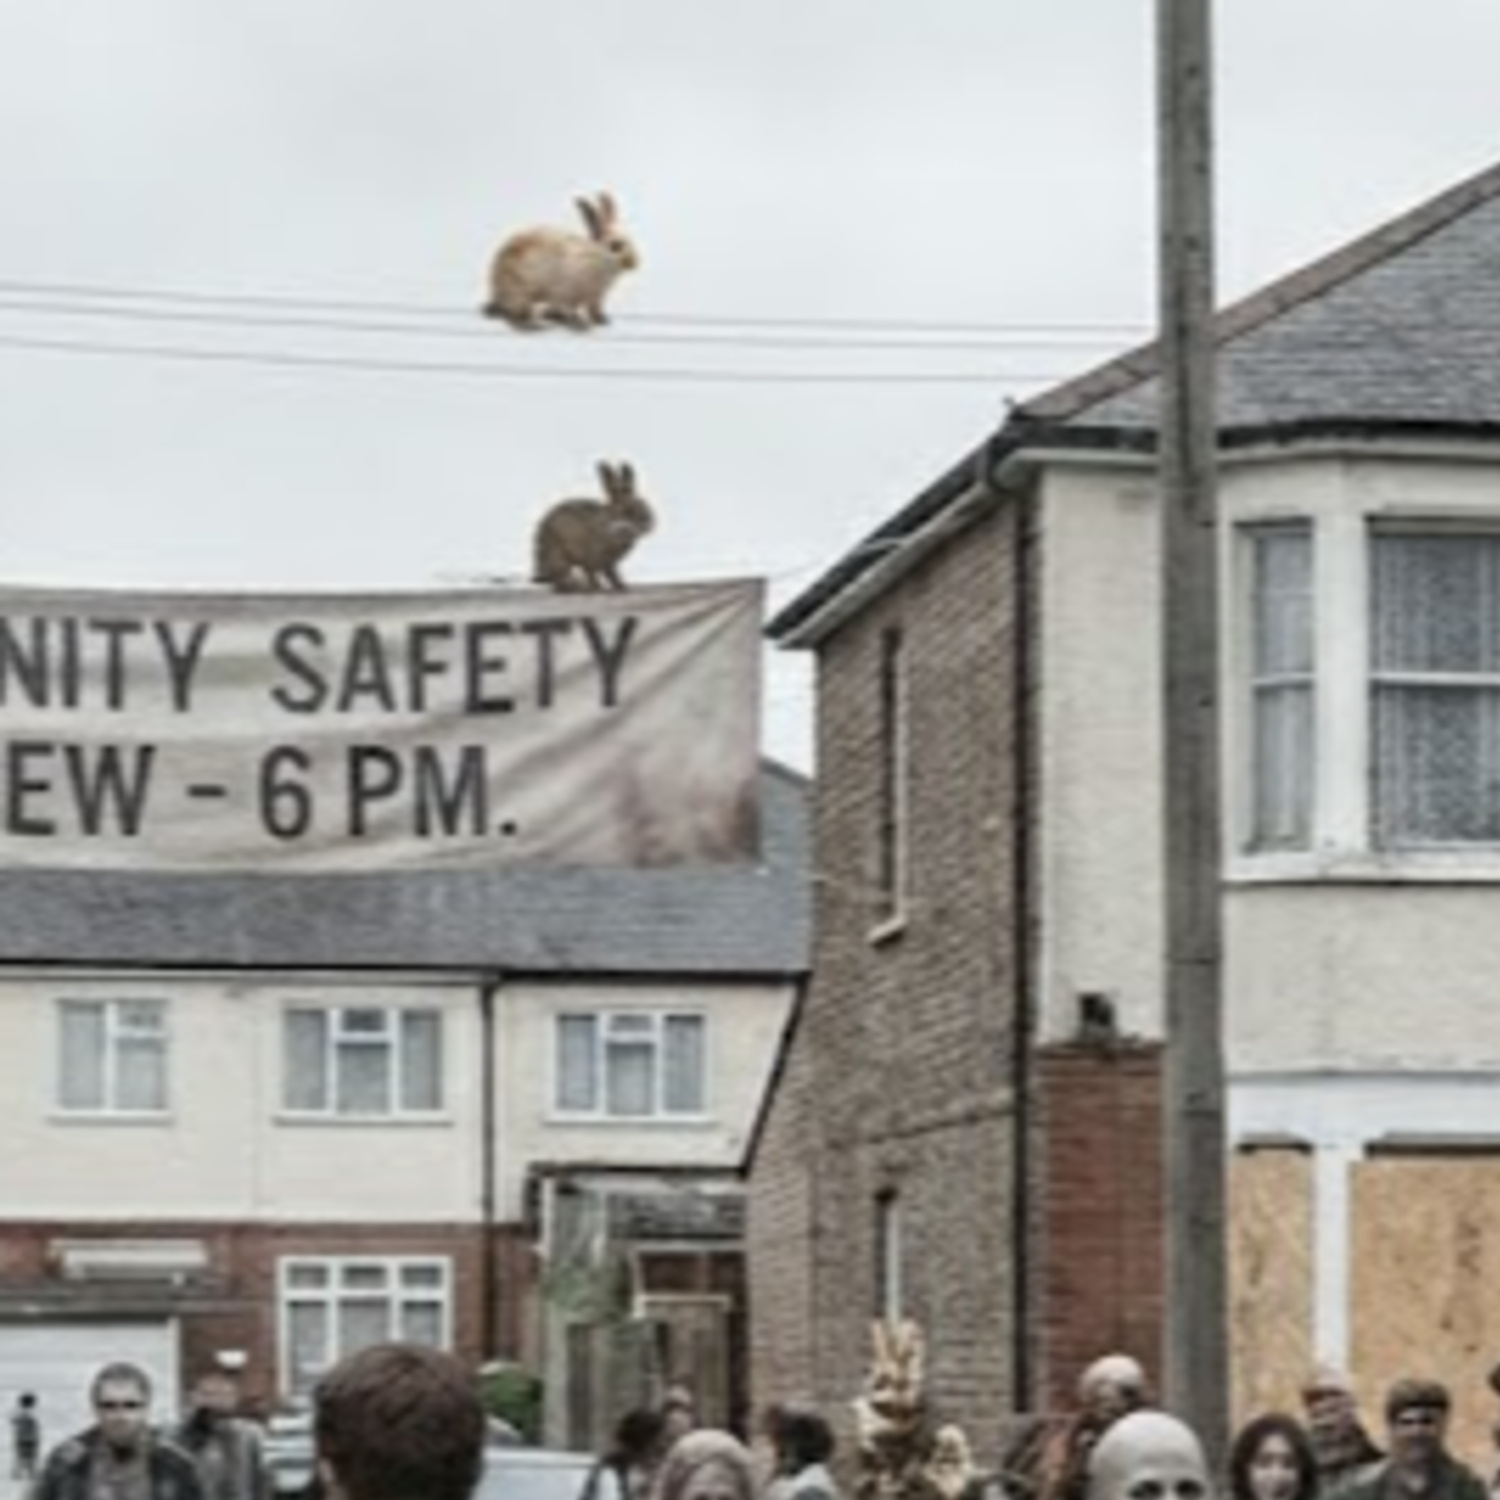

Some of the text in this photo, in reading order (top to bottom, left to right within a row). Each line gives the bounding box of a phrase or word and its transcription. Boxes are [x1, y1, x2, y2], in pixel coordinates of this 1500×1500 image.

[0, 616, 638, 717] NITY SAFETY
[6, 740, 157, 837] EW
[259, 744, 312, 841] 6
[347, 744, 518, 839] PM.
